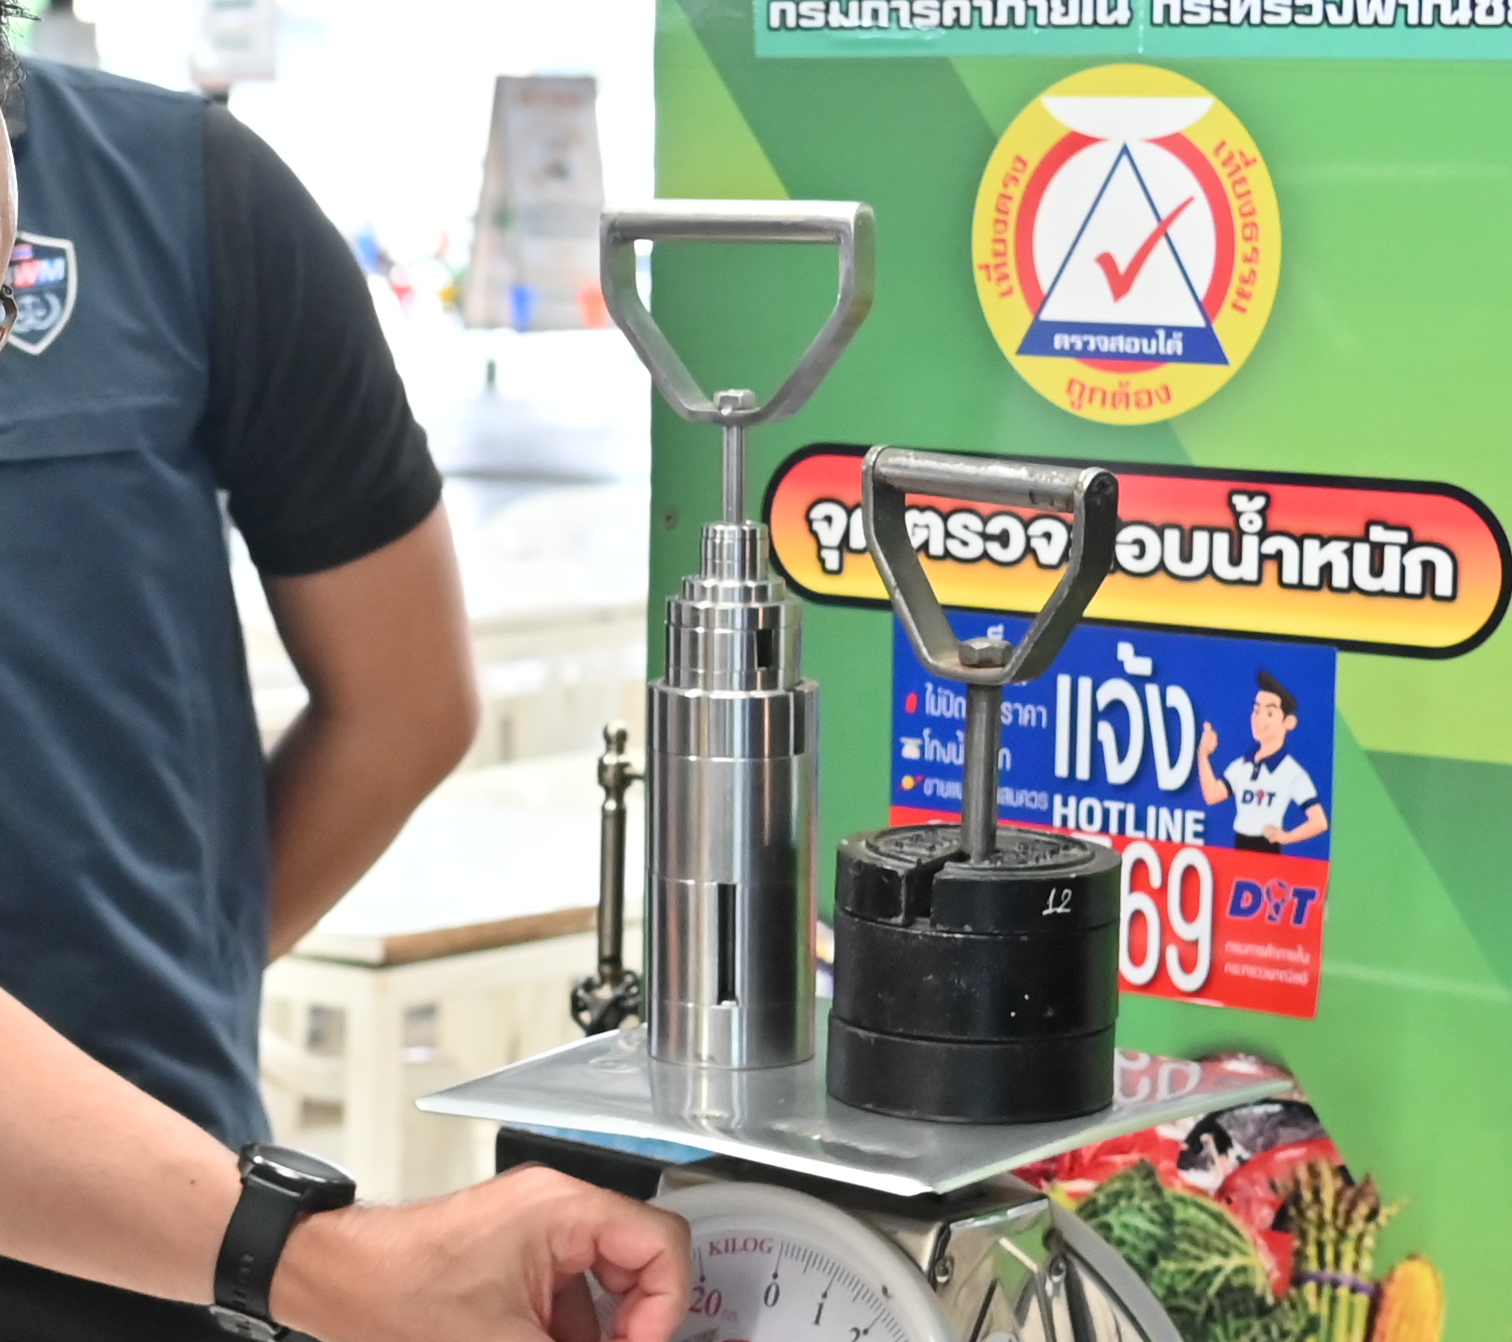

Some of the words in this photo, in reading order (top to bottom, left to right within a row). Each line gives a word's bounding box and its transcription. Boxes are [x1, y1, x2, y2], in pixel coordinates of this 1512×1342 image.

[978, 154, 1028, 299] เที่ยงตรง
[1212, 139, 1261, 314] เที่ยงธรรม
[1053, 329, 1184, 357] ตรวจสอบได้
[1065, 376, 1173, 411] ถูกต้อง
[808, 495, 1456, 599] จุตรวจอบน้ำหนัก
[1054, 641, 1197, 791] แจ้ง
[1052, 792, 1206, 846] HOTLINE
[1042, 887, 1073, 916] 12
[1119, 840, 1214, 993] 69
[708, 1237, 774, 1257] KILOG
[688, 1285, 723, 1318] 20
[762, 1281, 780, 1308] 0
[813, 1301, 825, 1326] 1
